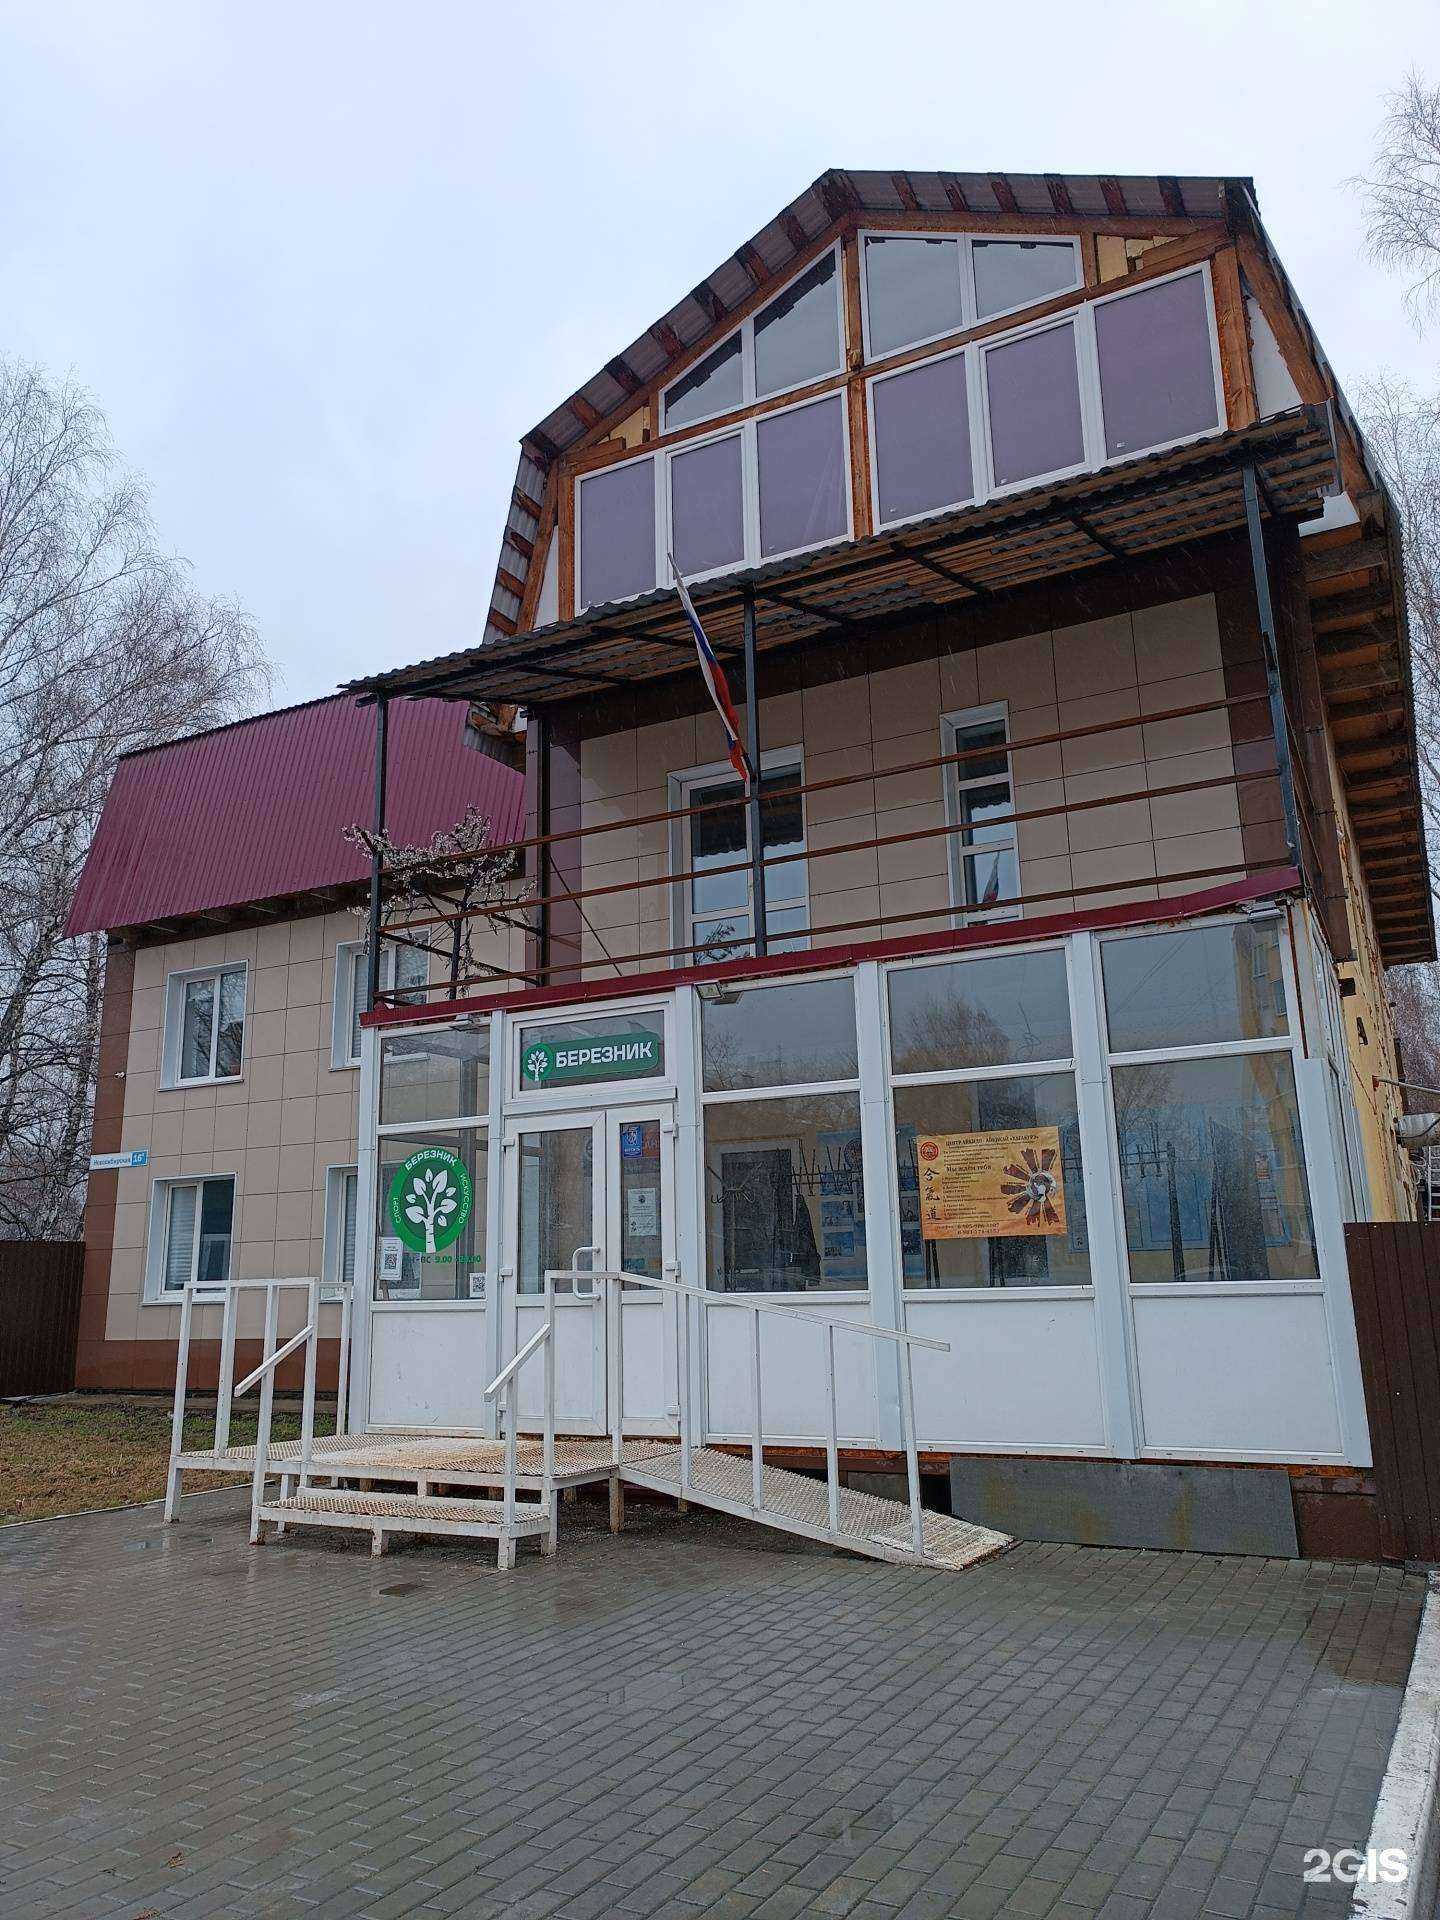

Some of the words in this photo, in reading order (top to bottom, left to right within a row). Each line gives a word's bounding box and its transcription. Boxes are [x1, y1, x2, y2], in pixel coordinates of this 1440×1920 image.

[555, 1041, 652, 1068] БЕРЕЗНИК
[405, 1150, 458, 1171] БЕРЕЗНИК
[392, 1197, 402, 1224] СПОРТ
[458, 1173, 472, 1224] ИСКУССТВО
